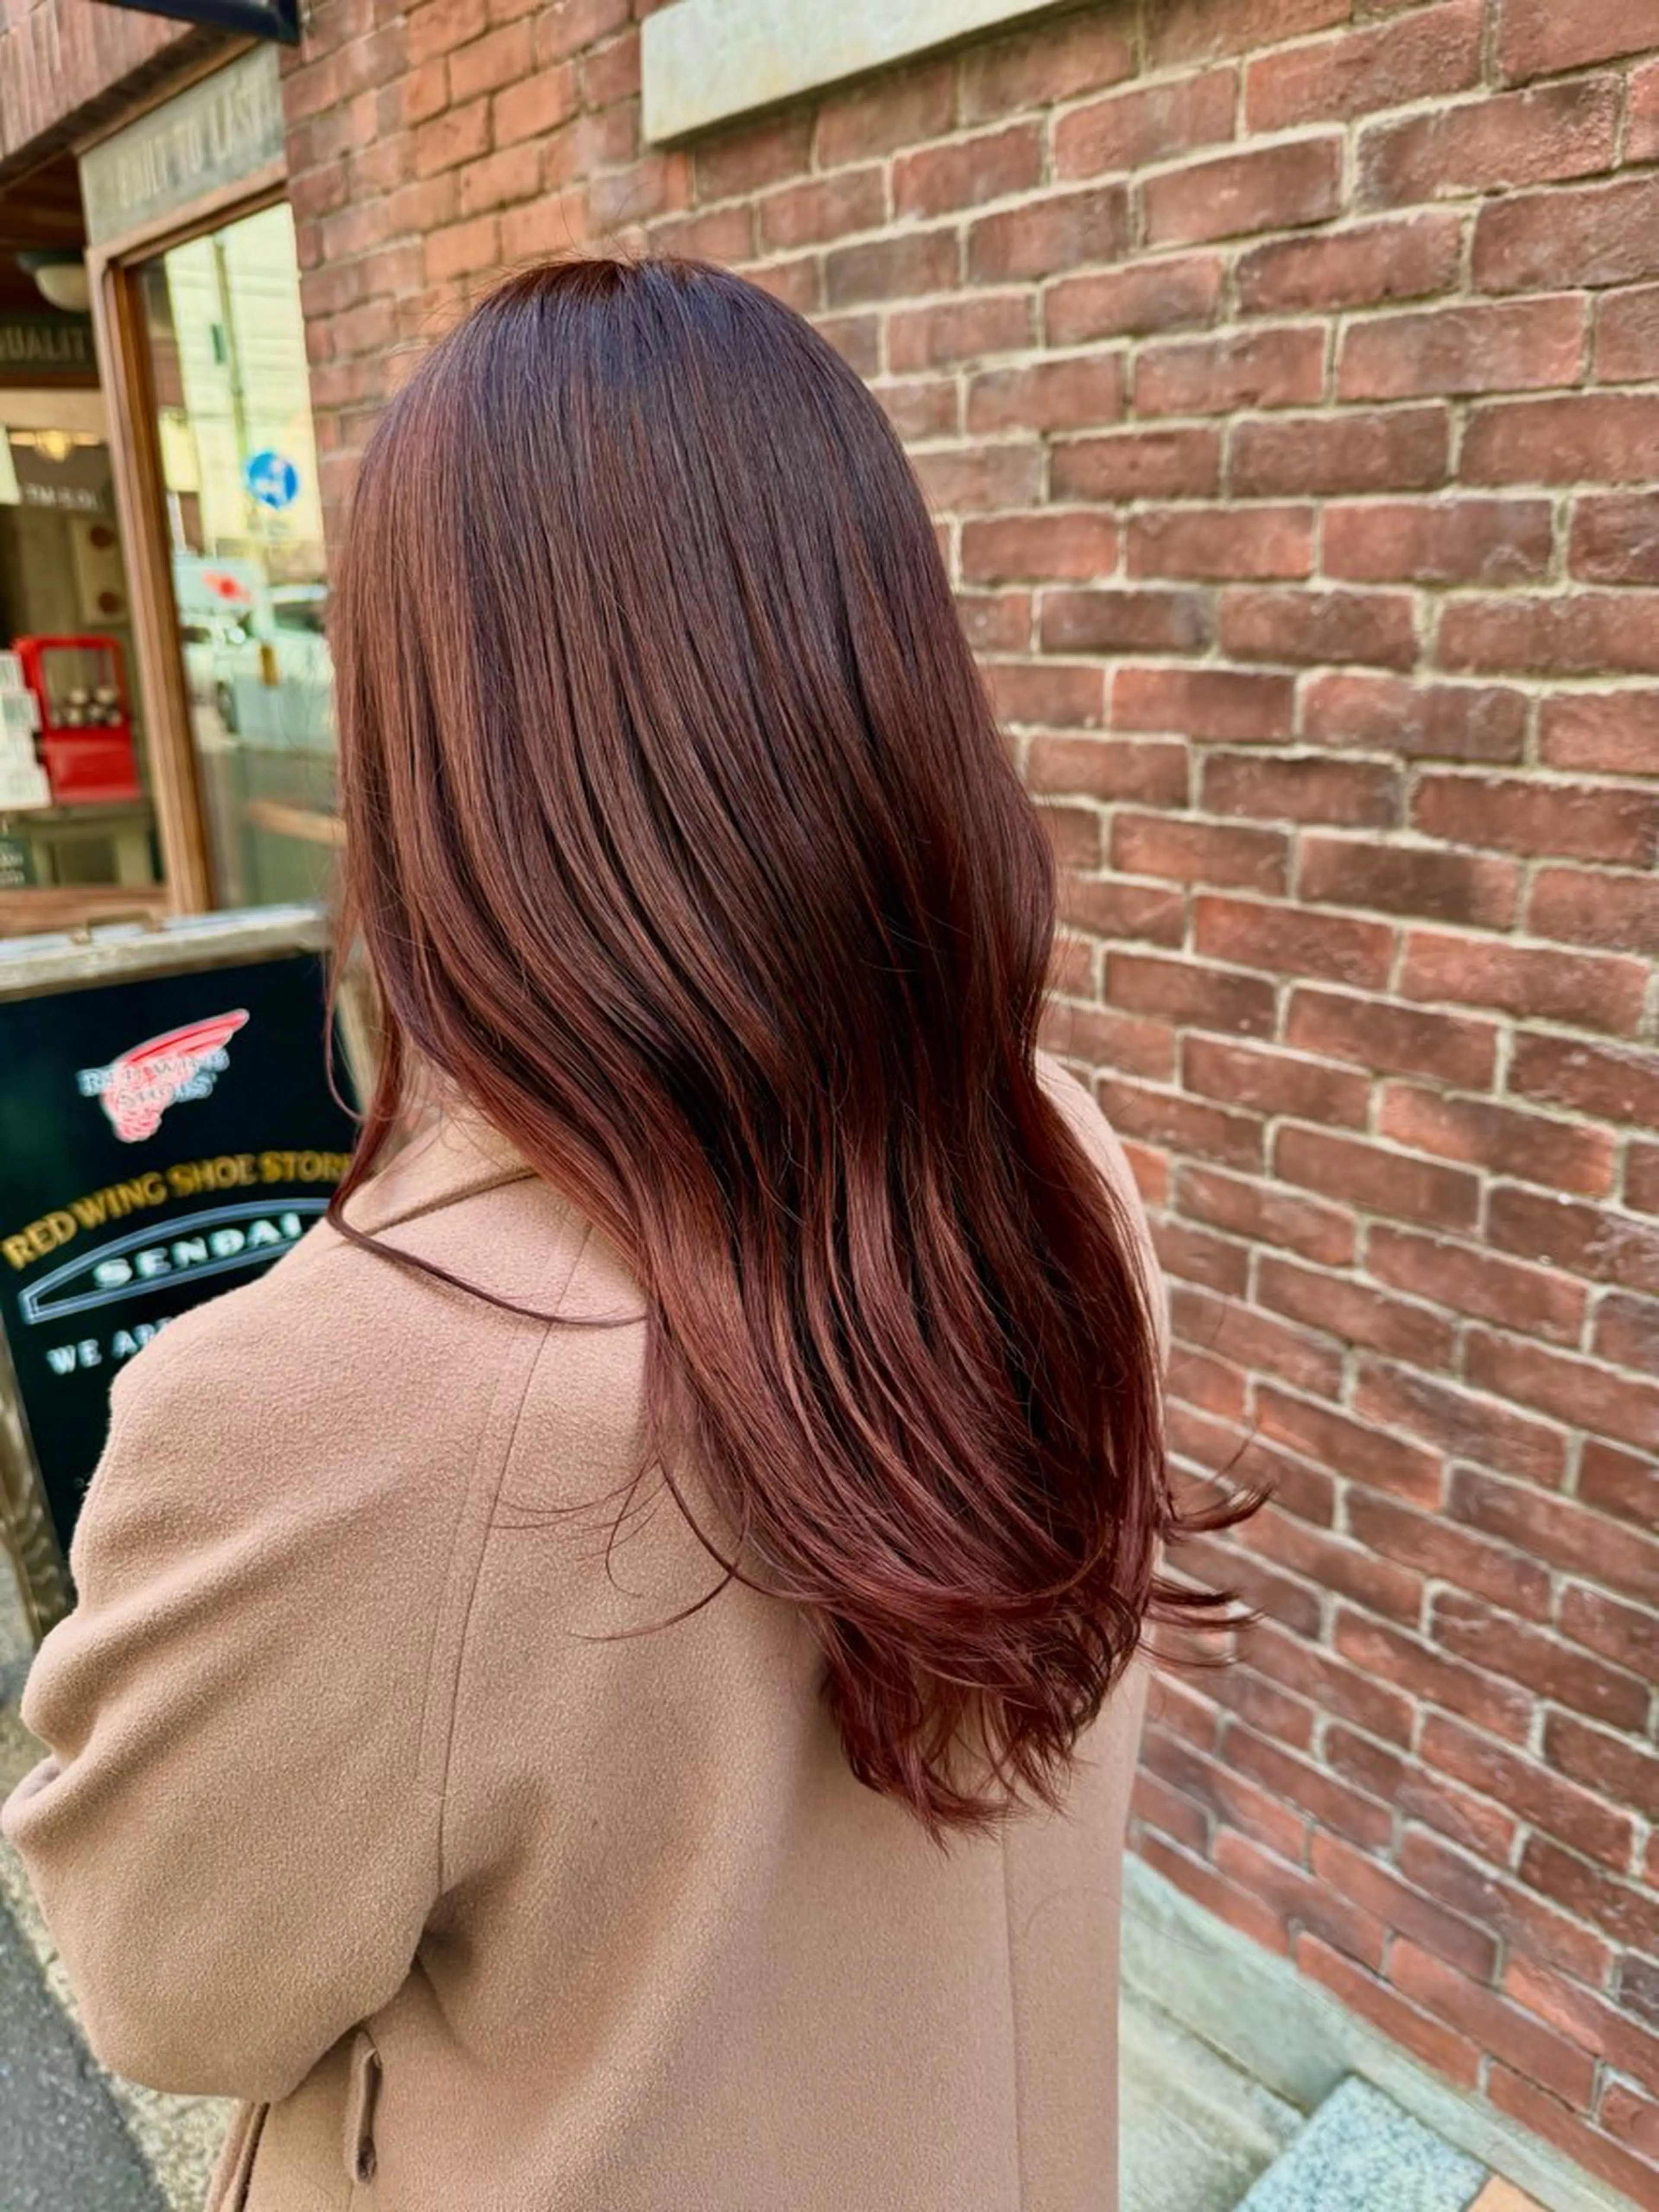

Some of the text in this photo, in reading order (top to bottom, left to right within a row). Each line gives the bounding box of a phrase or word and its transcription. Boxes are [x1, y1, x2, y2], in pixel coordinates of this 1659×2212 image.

[2, 1211, 78, 1271] RED
[68, 1171, 167, 1230] WING
[167, 1153, 258, 1197] SHOE
[93, 1212, 302, 1289] SENDAI
[46, 1316, 174, 1375] WE AR
